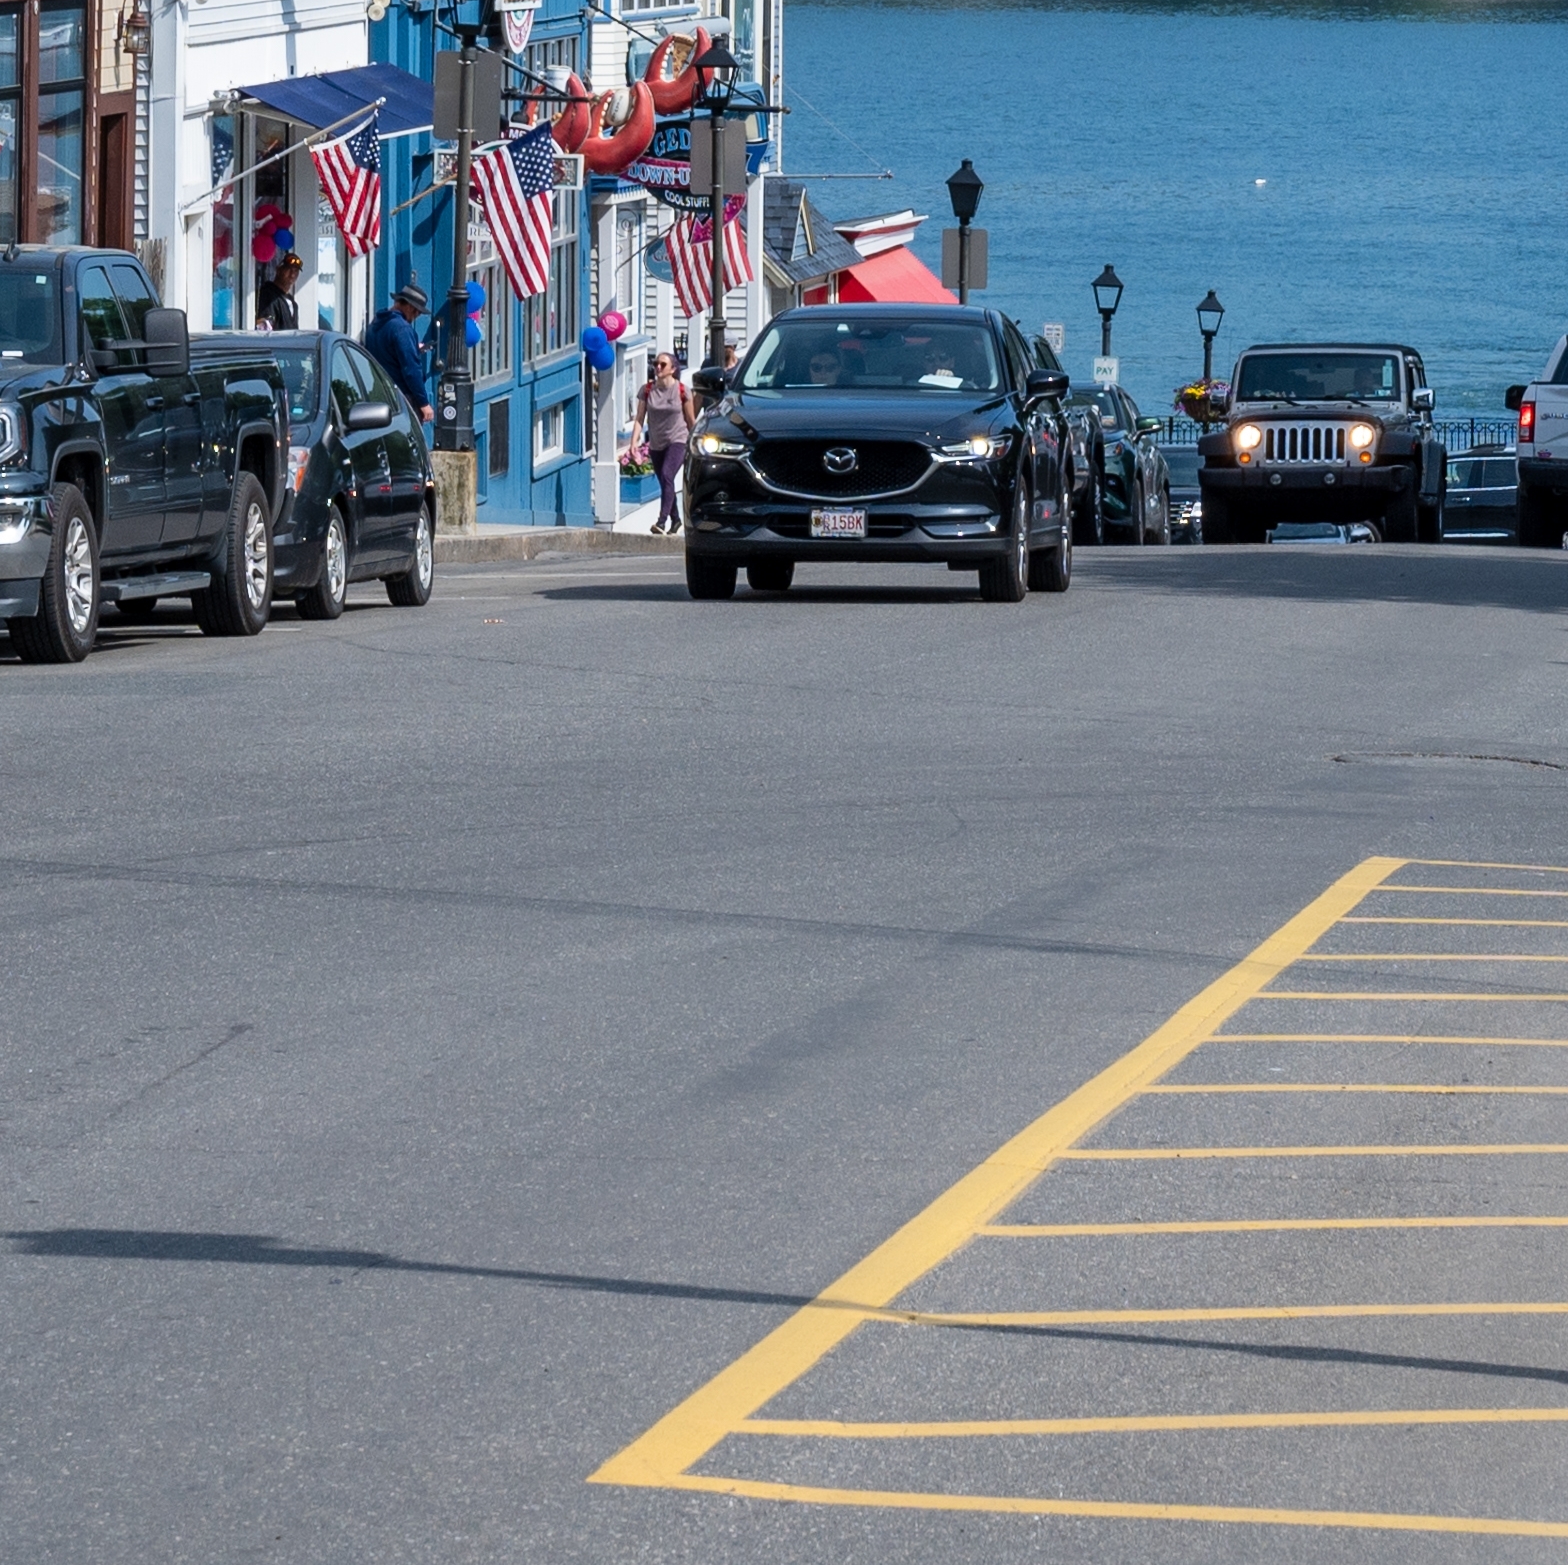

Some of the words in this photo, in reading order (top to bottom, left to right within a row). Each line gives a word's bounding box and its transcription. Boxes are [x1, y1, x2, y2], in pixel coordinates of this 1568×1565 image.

[628, 162, 691, 185] DOWN-U
[664, 190, 685, 207] COOL
[686, 196, 710, 208] STUFF!
[1096, 366, 1113, 375] PAY
